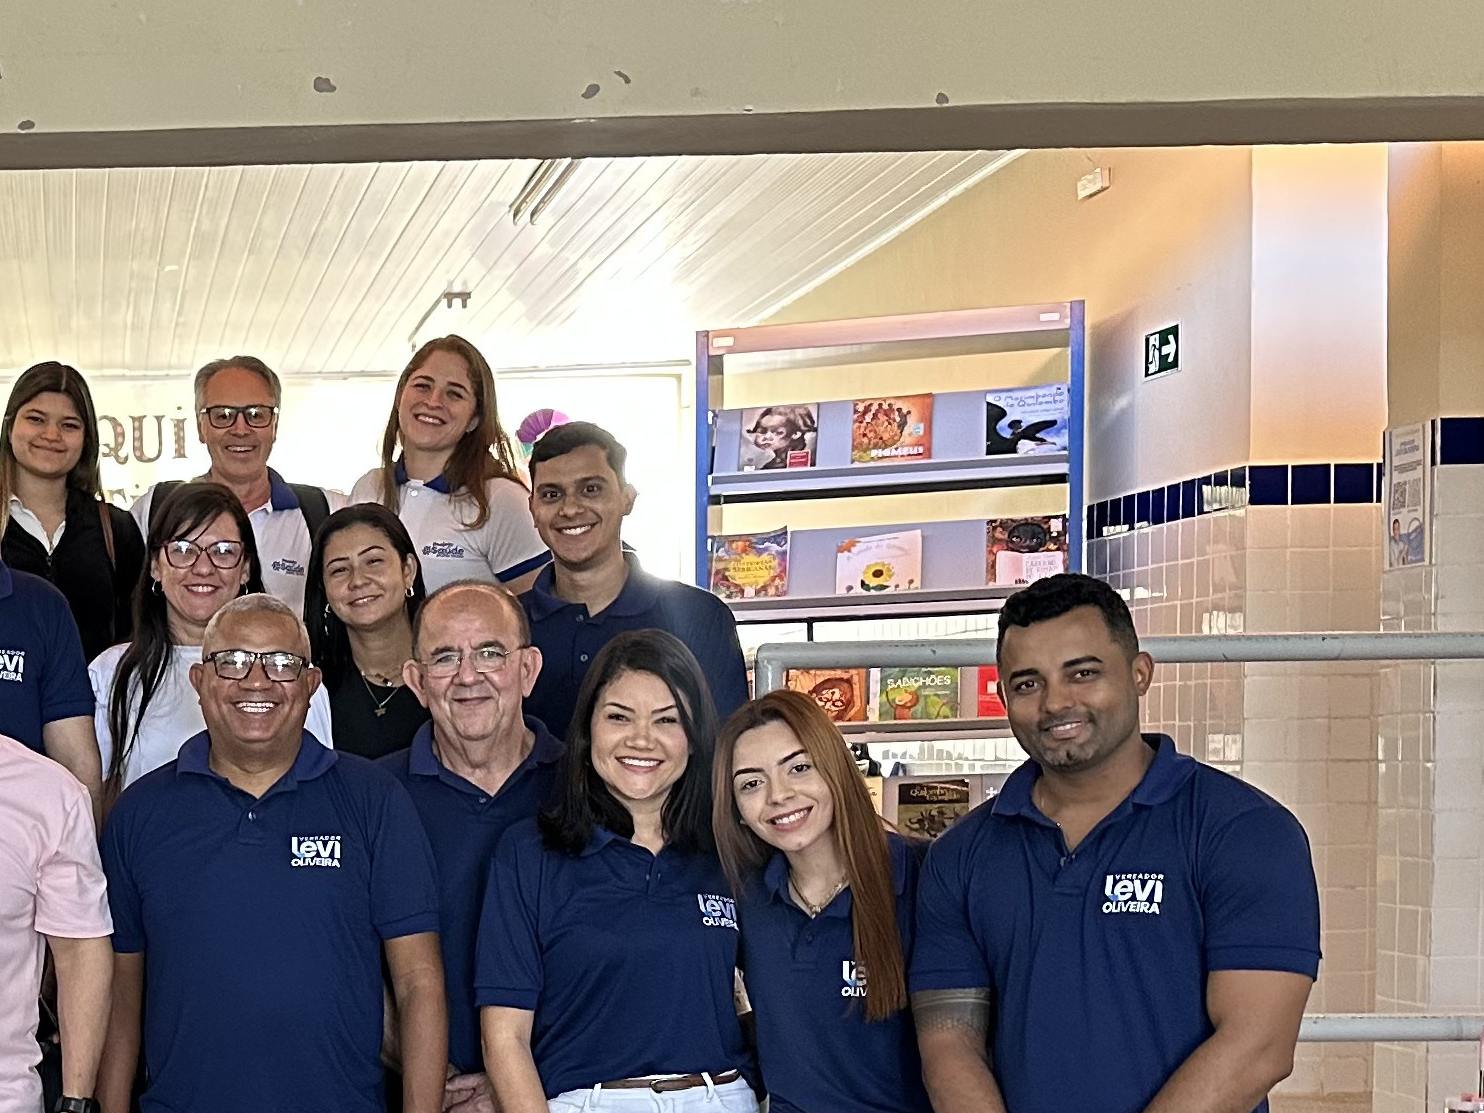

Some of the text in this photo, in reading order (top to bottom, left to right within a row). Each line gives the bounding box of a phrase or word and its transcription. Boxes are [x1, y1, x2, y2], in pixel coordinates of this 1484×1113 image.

[886, 674, 951, 690] SABICHÕES
[291, 857, 341, 868] OLIVEIRA
[1102, 901, 1160, 914] OLIVEIRA
[841, 986, 868, 997] OLIV
